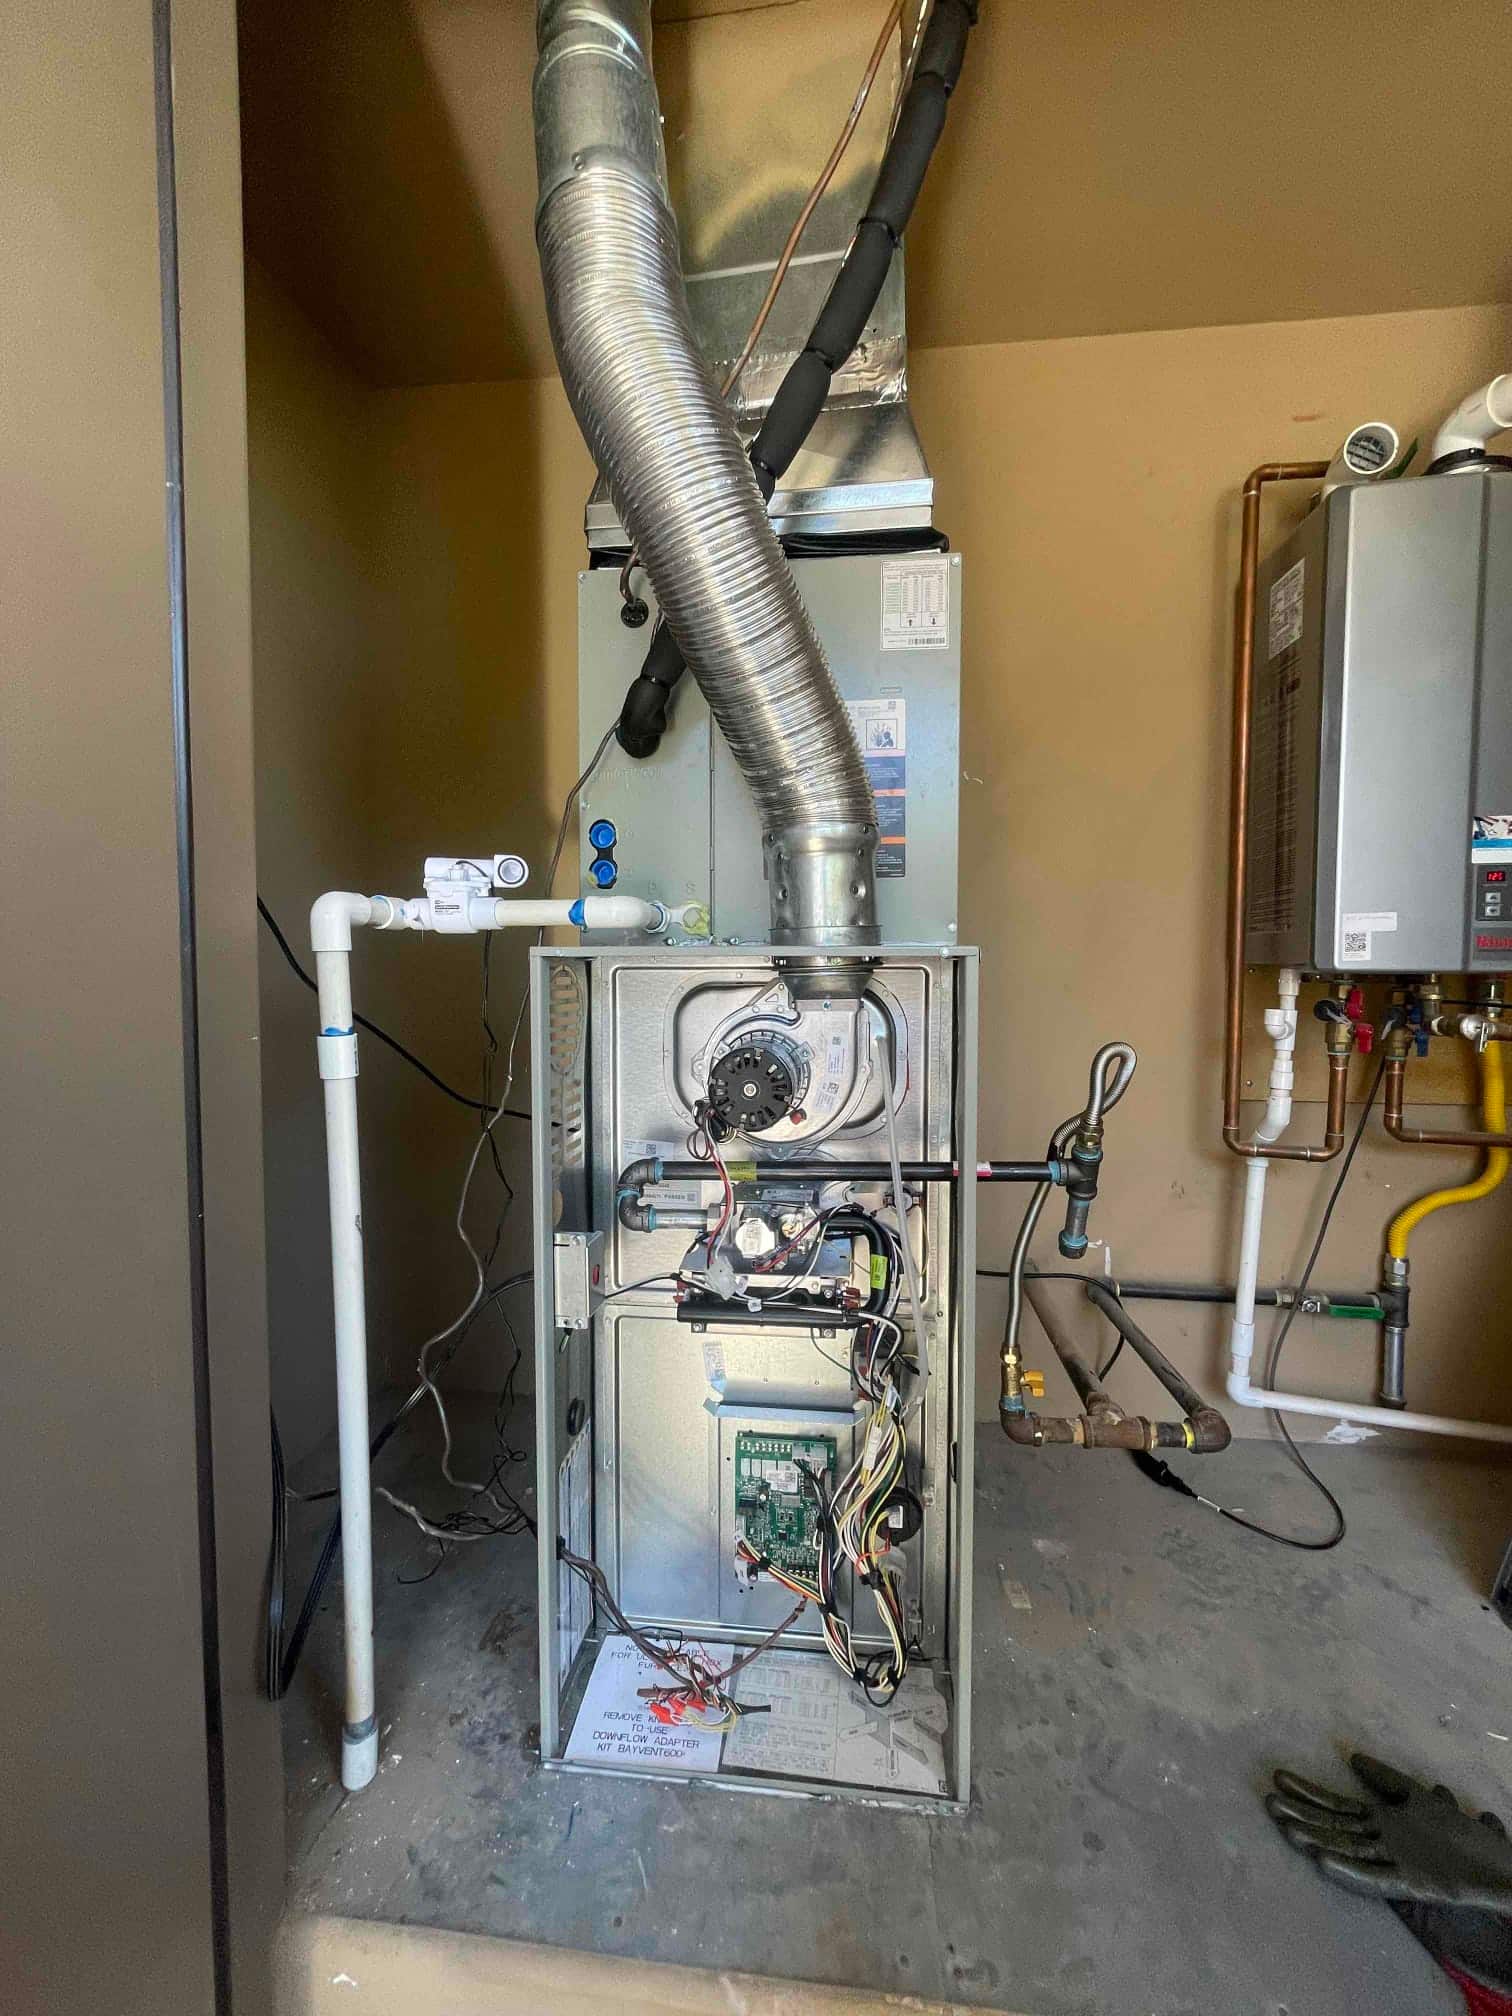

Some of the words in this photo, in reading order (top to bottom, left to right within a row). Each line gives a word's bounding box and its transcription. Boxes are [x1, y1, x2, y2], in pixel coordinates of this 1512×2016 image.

[611, 1651, 631, 1660] FOR
[603, 1711, 643, 1722] REMOVE
[631, 1723, 643, 1733] TO
[649, 1726, 670, 1735] USE
[592, 1731, 648, 1744] DOWNFLOW
[654, 1736, 700, 1749] ADAPTER
[597, 1742, 612, 1752] KIT
